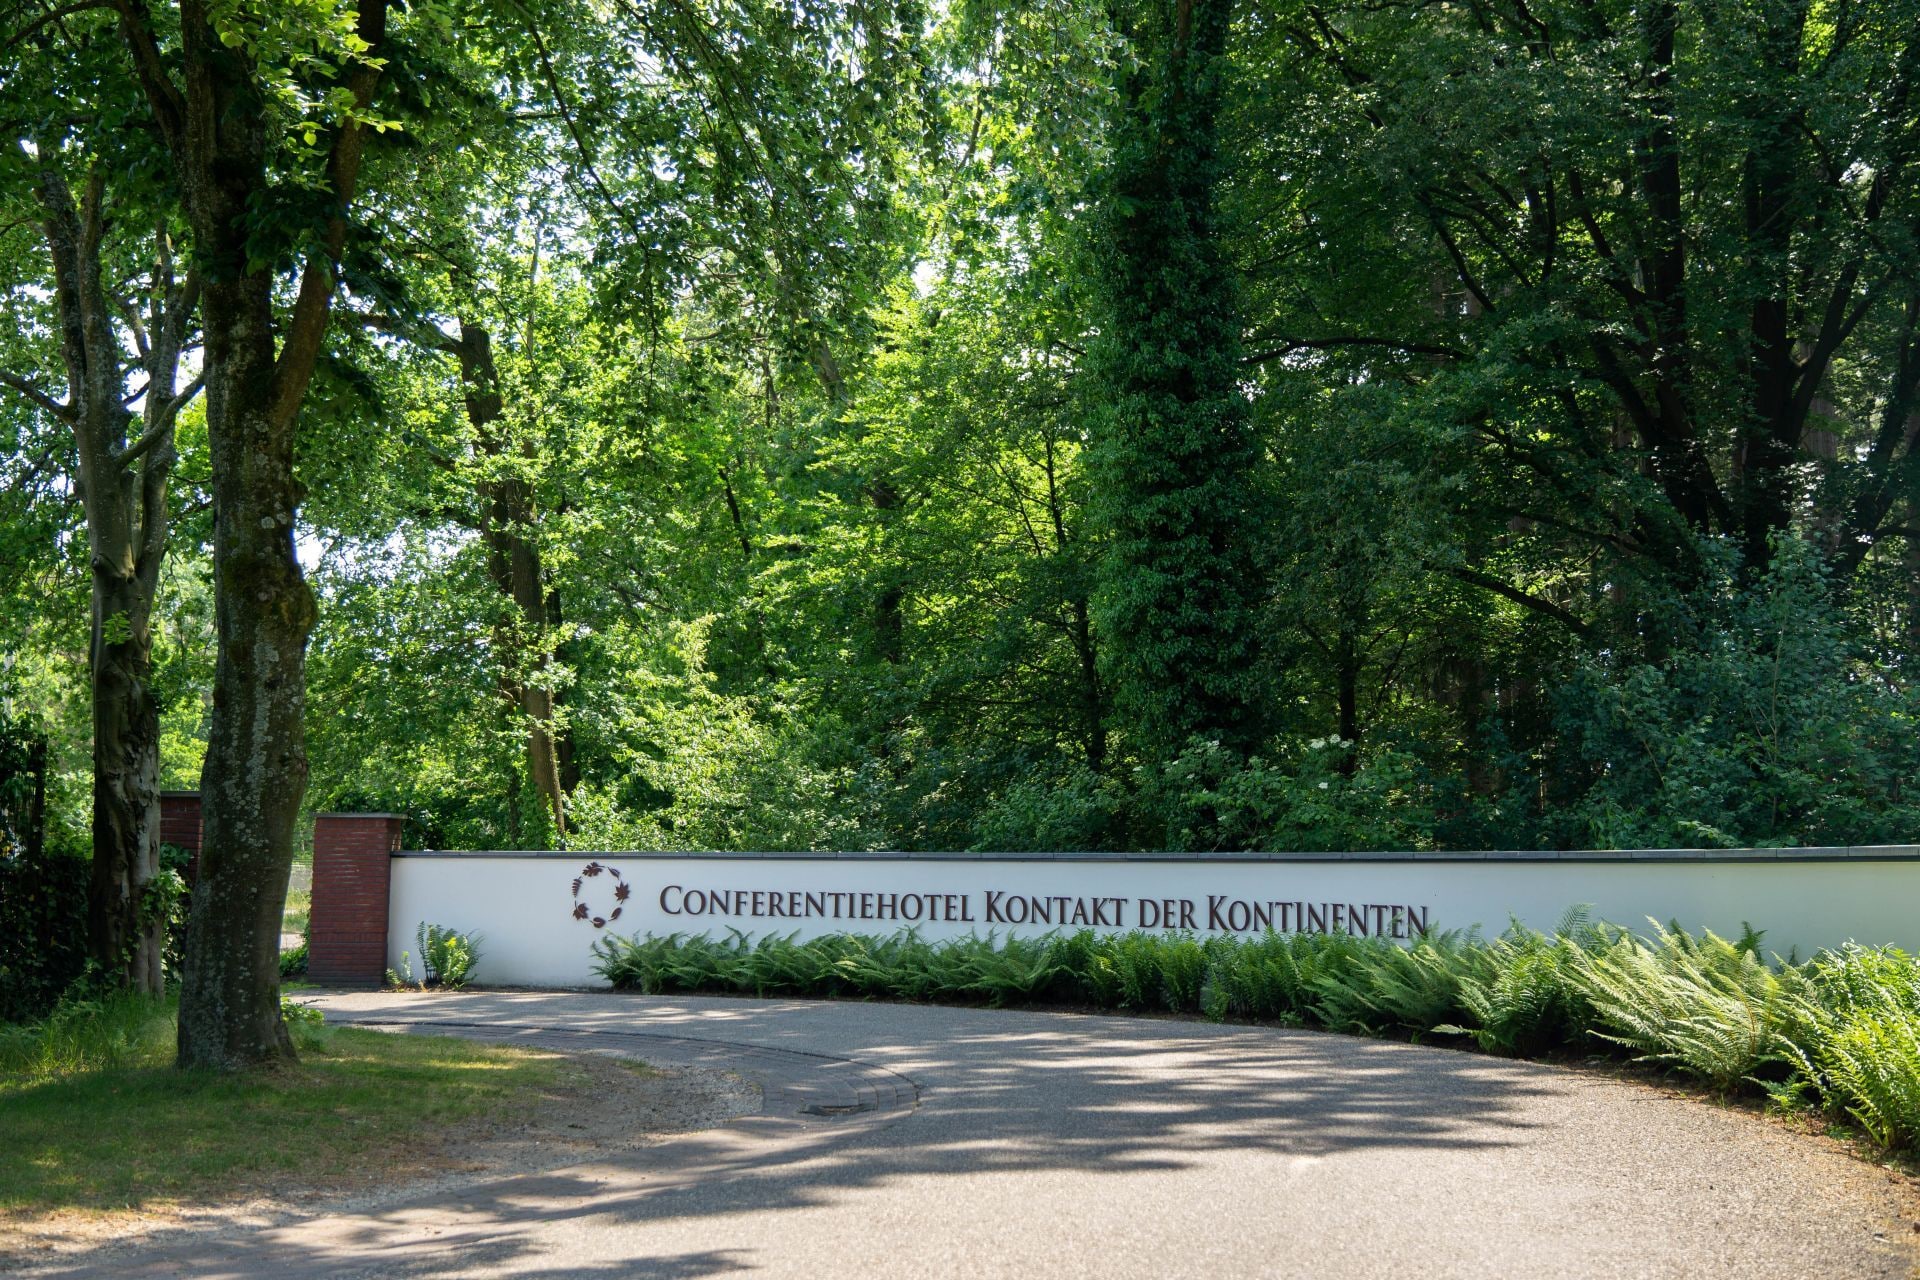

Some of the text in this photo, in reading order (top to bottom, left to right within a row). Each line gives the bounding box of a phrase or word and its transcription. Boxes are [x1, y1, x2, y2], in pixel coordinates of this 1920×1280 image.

[659, 885, 1429, 939] CONFERENTIEHOTEL KONTAKT DER KONTINENTEN
